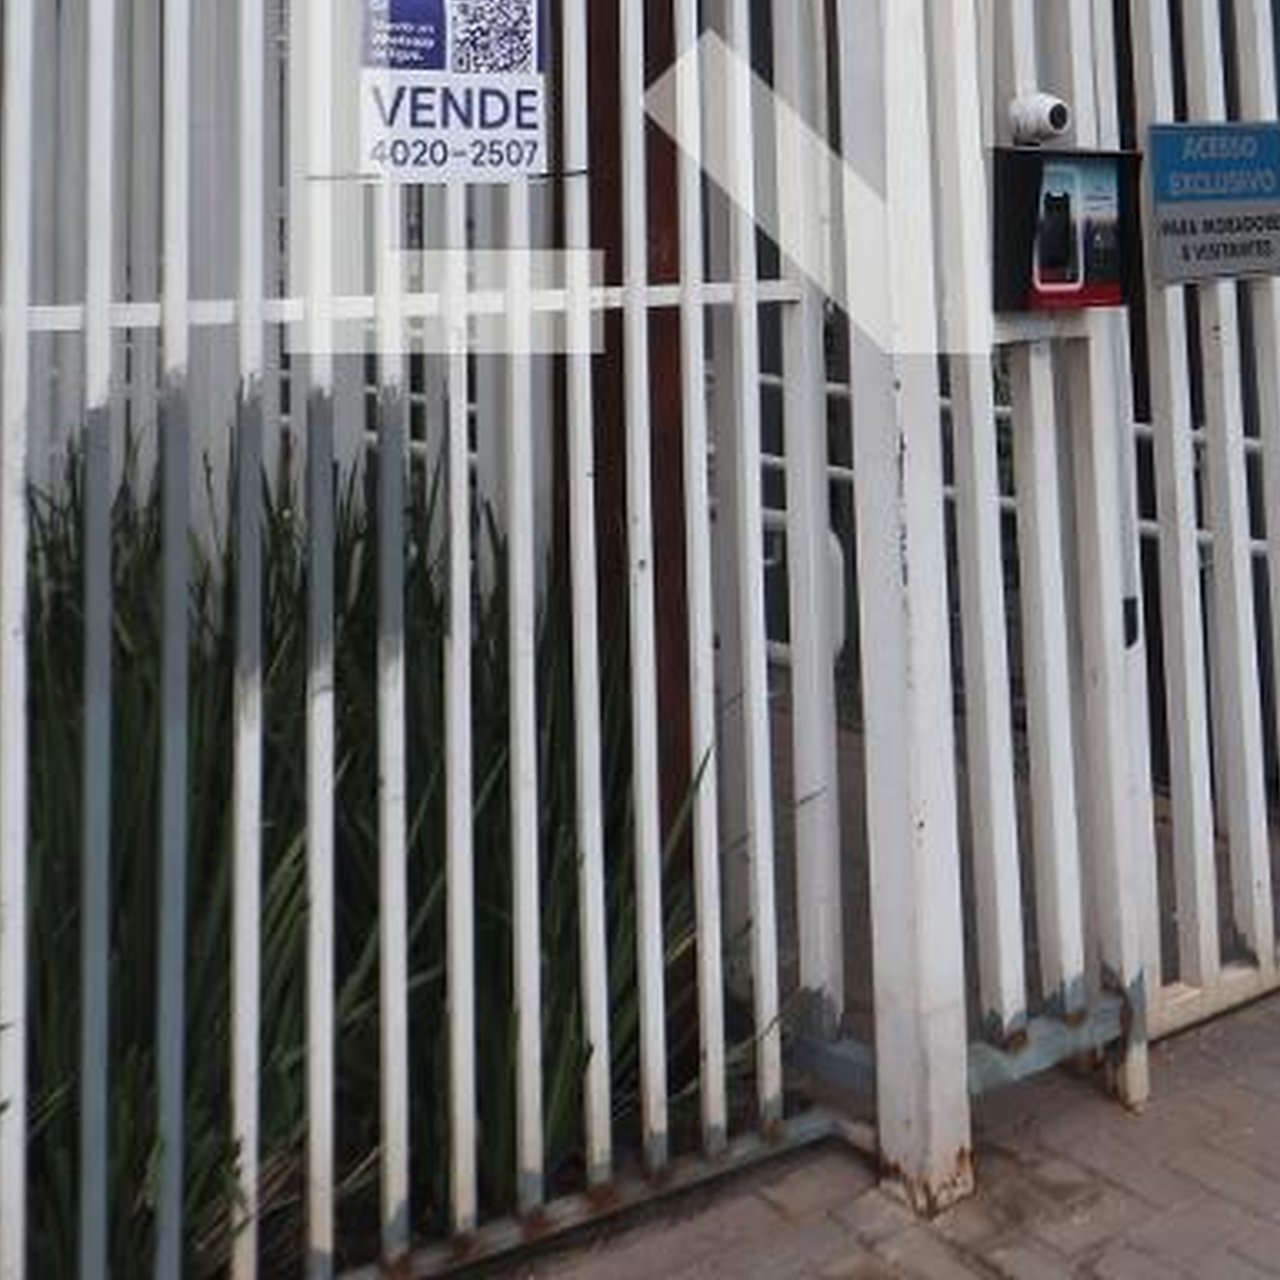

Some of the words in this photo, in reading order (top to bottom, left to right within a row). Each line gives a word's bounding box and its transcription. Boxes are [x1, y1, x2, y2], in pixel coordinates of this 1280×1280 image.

[372, 86, 539, 130] VENDE
[370, 138, 539, 167] 4020-2507
[1181, 136, 1259, 161] ACESSO
[1170, 168, 1276, 194] EXCLUSIVO
